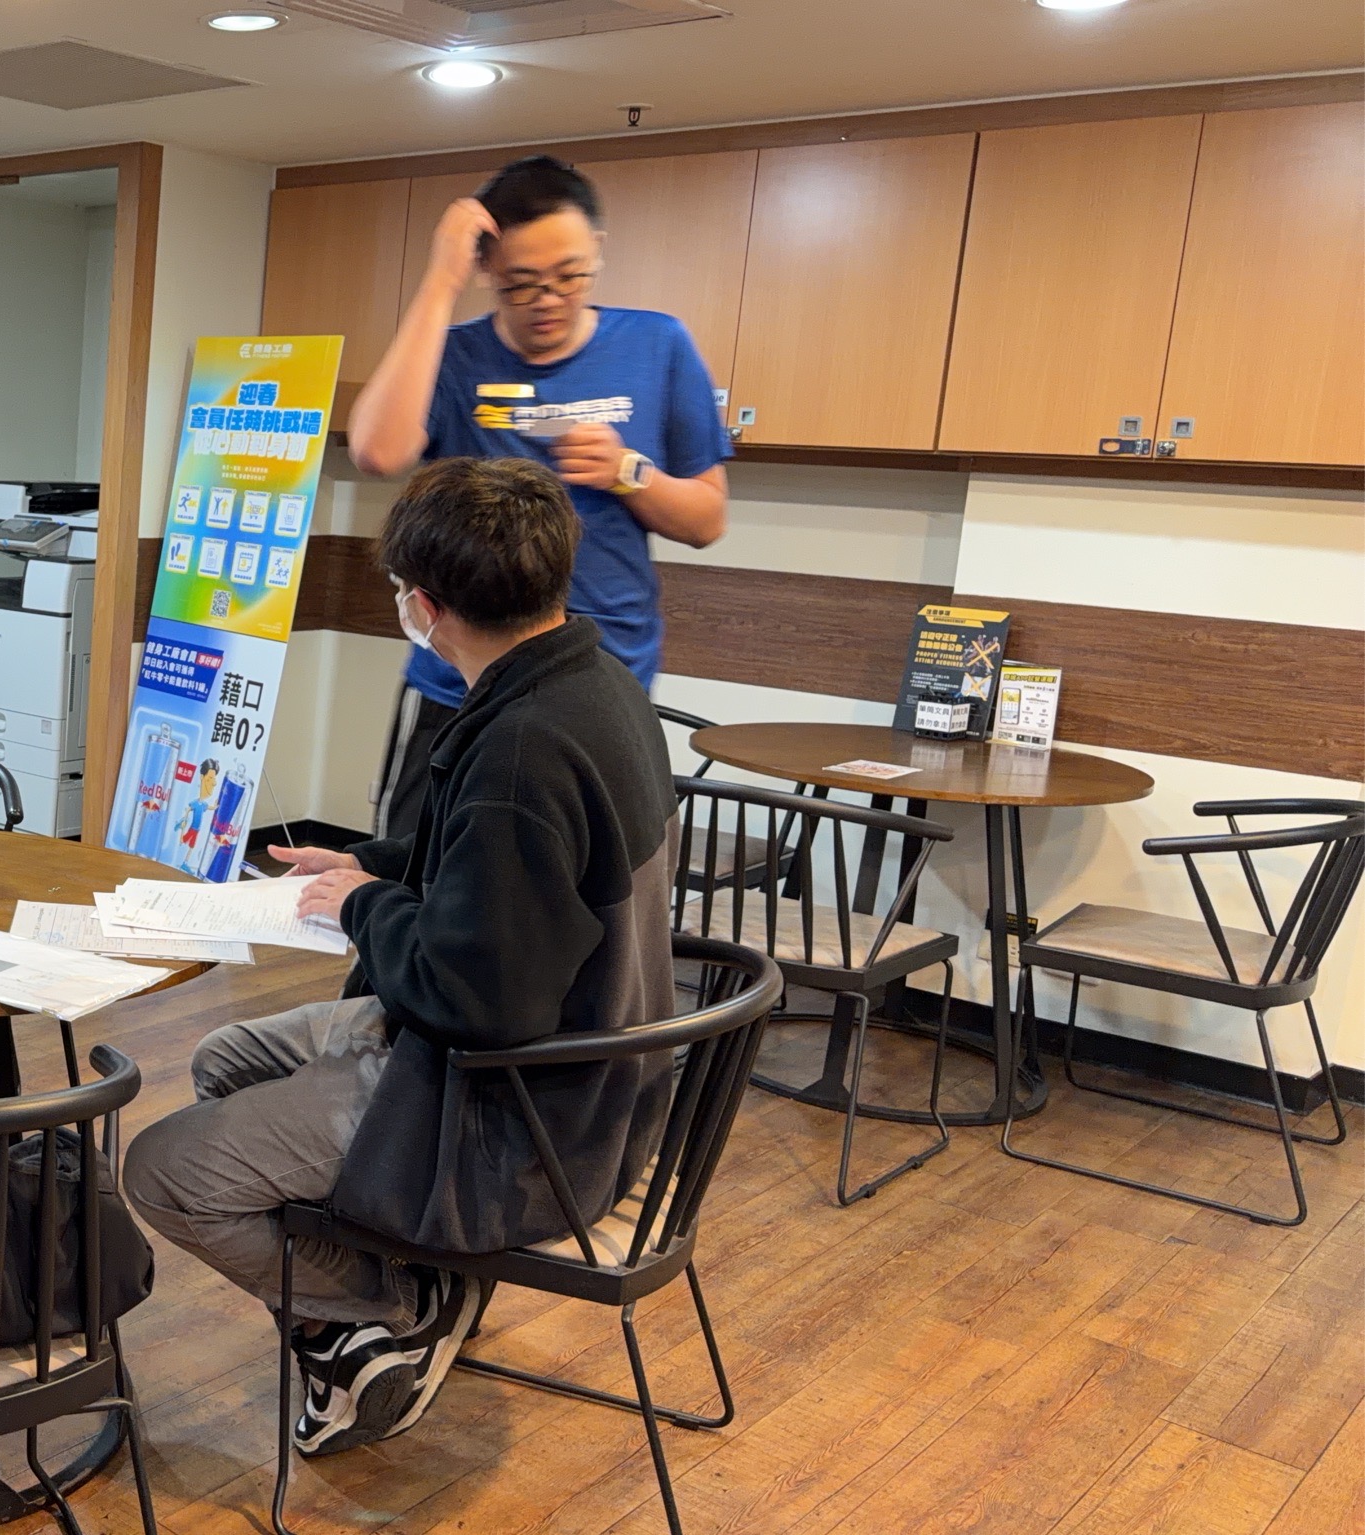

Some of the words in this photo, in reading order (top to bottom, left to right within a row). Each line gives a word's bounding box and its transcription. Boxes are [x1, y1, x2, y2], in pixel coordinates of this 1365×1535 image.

[238, 382, 278, 407] 迎春
[189, 406, 323, 436] 會員任務挑戰牆
[146, 641, 197, 663] 健身工廠會員
[219, 671, 264, 712] 藉口
[139, 780, 154, 797] Red
